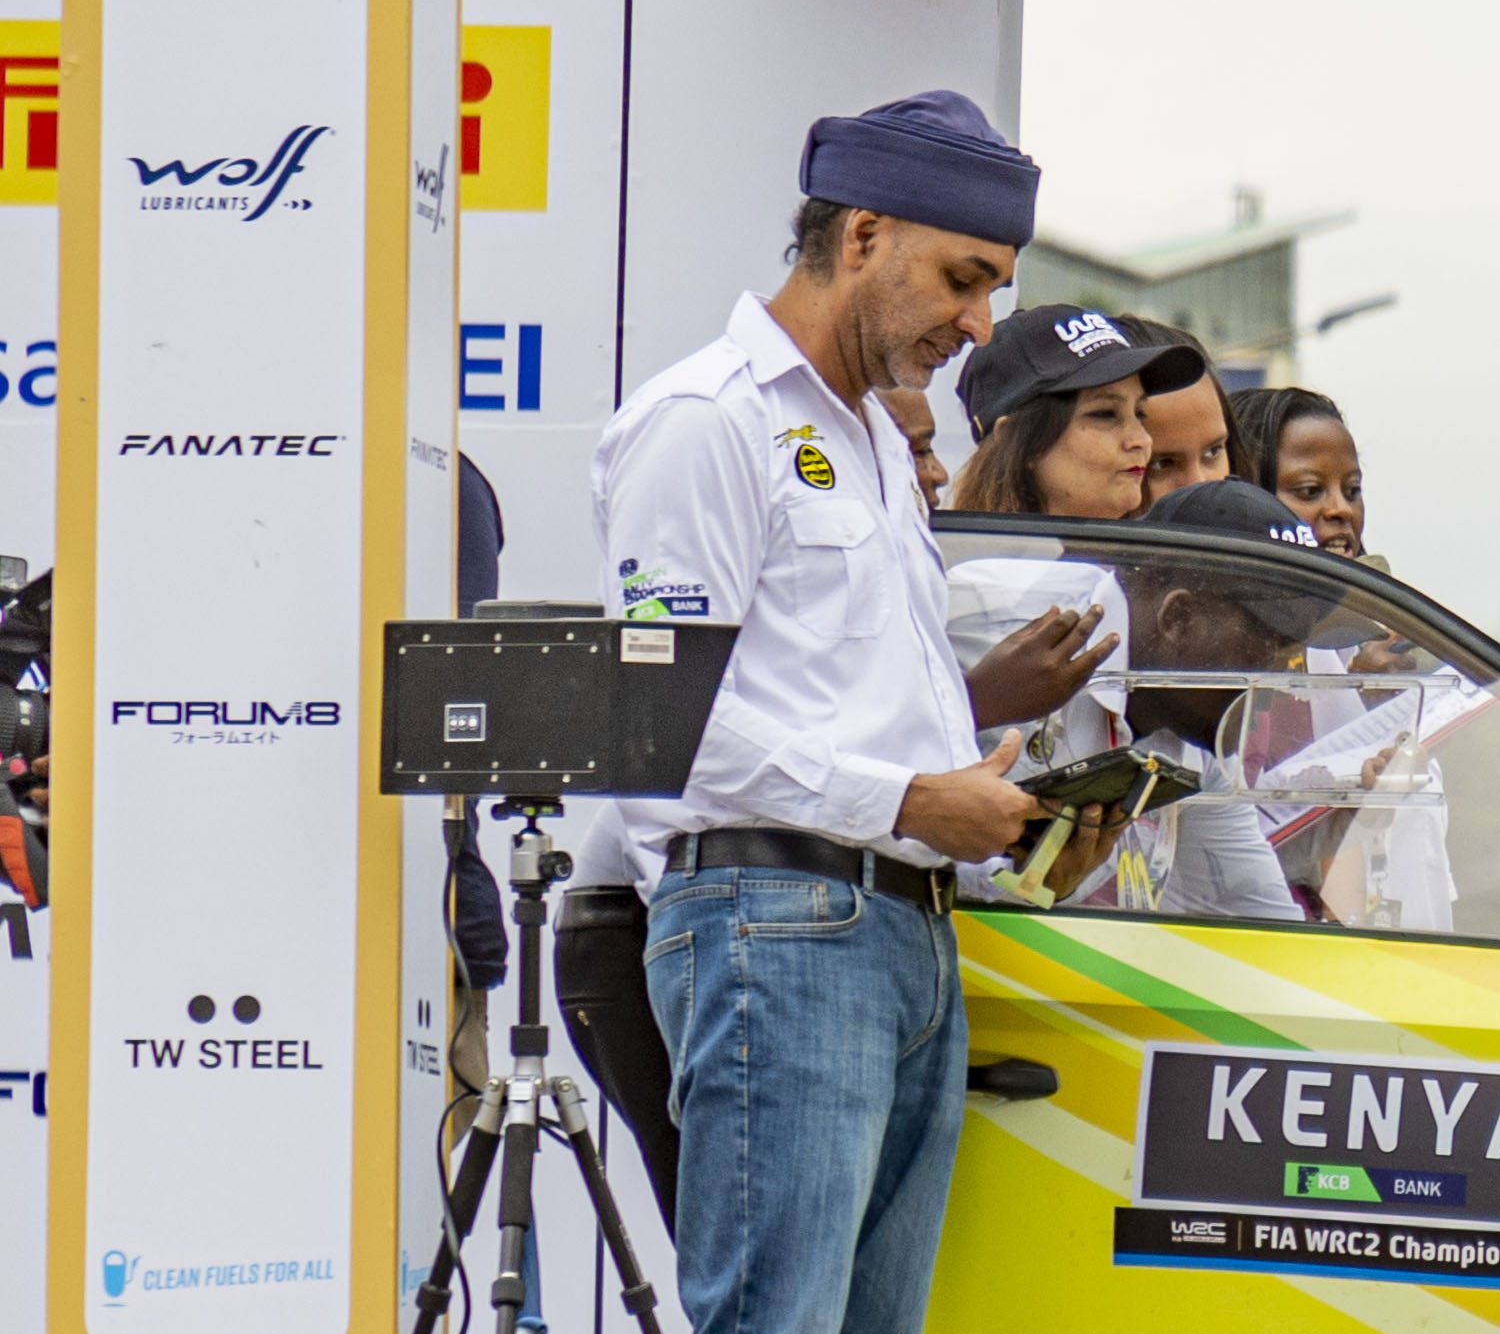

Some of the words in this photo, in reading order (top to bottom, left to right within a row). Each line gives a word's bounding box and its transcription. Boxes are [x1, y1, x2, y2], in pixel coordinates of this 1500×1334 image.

[141, 197, 248, 210] LUBRICANTS
[120, 435, 337, 456] FANATEC
[113, 702, 340, 725] FORUM8
[125, 1040, 184, 1068] TW
[199, 1040, 322, 1069] STEEL
[1318, 1174, 1349, 1190] KCB
[1394, 1179, 1441, 1196] BANK
[1255, 1225, 1297, 1250] FIA
[1305, 1228, 1380, 1256] WRC2
[143, 1268, 201, 1291] CLEAN
[205, 1263, 260, 1286] FUELS
[264, 1261, 299, 1283] FOR
[303, 1259, 334, 1280] ALL
